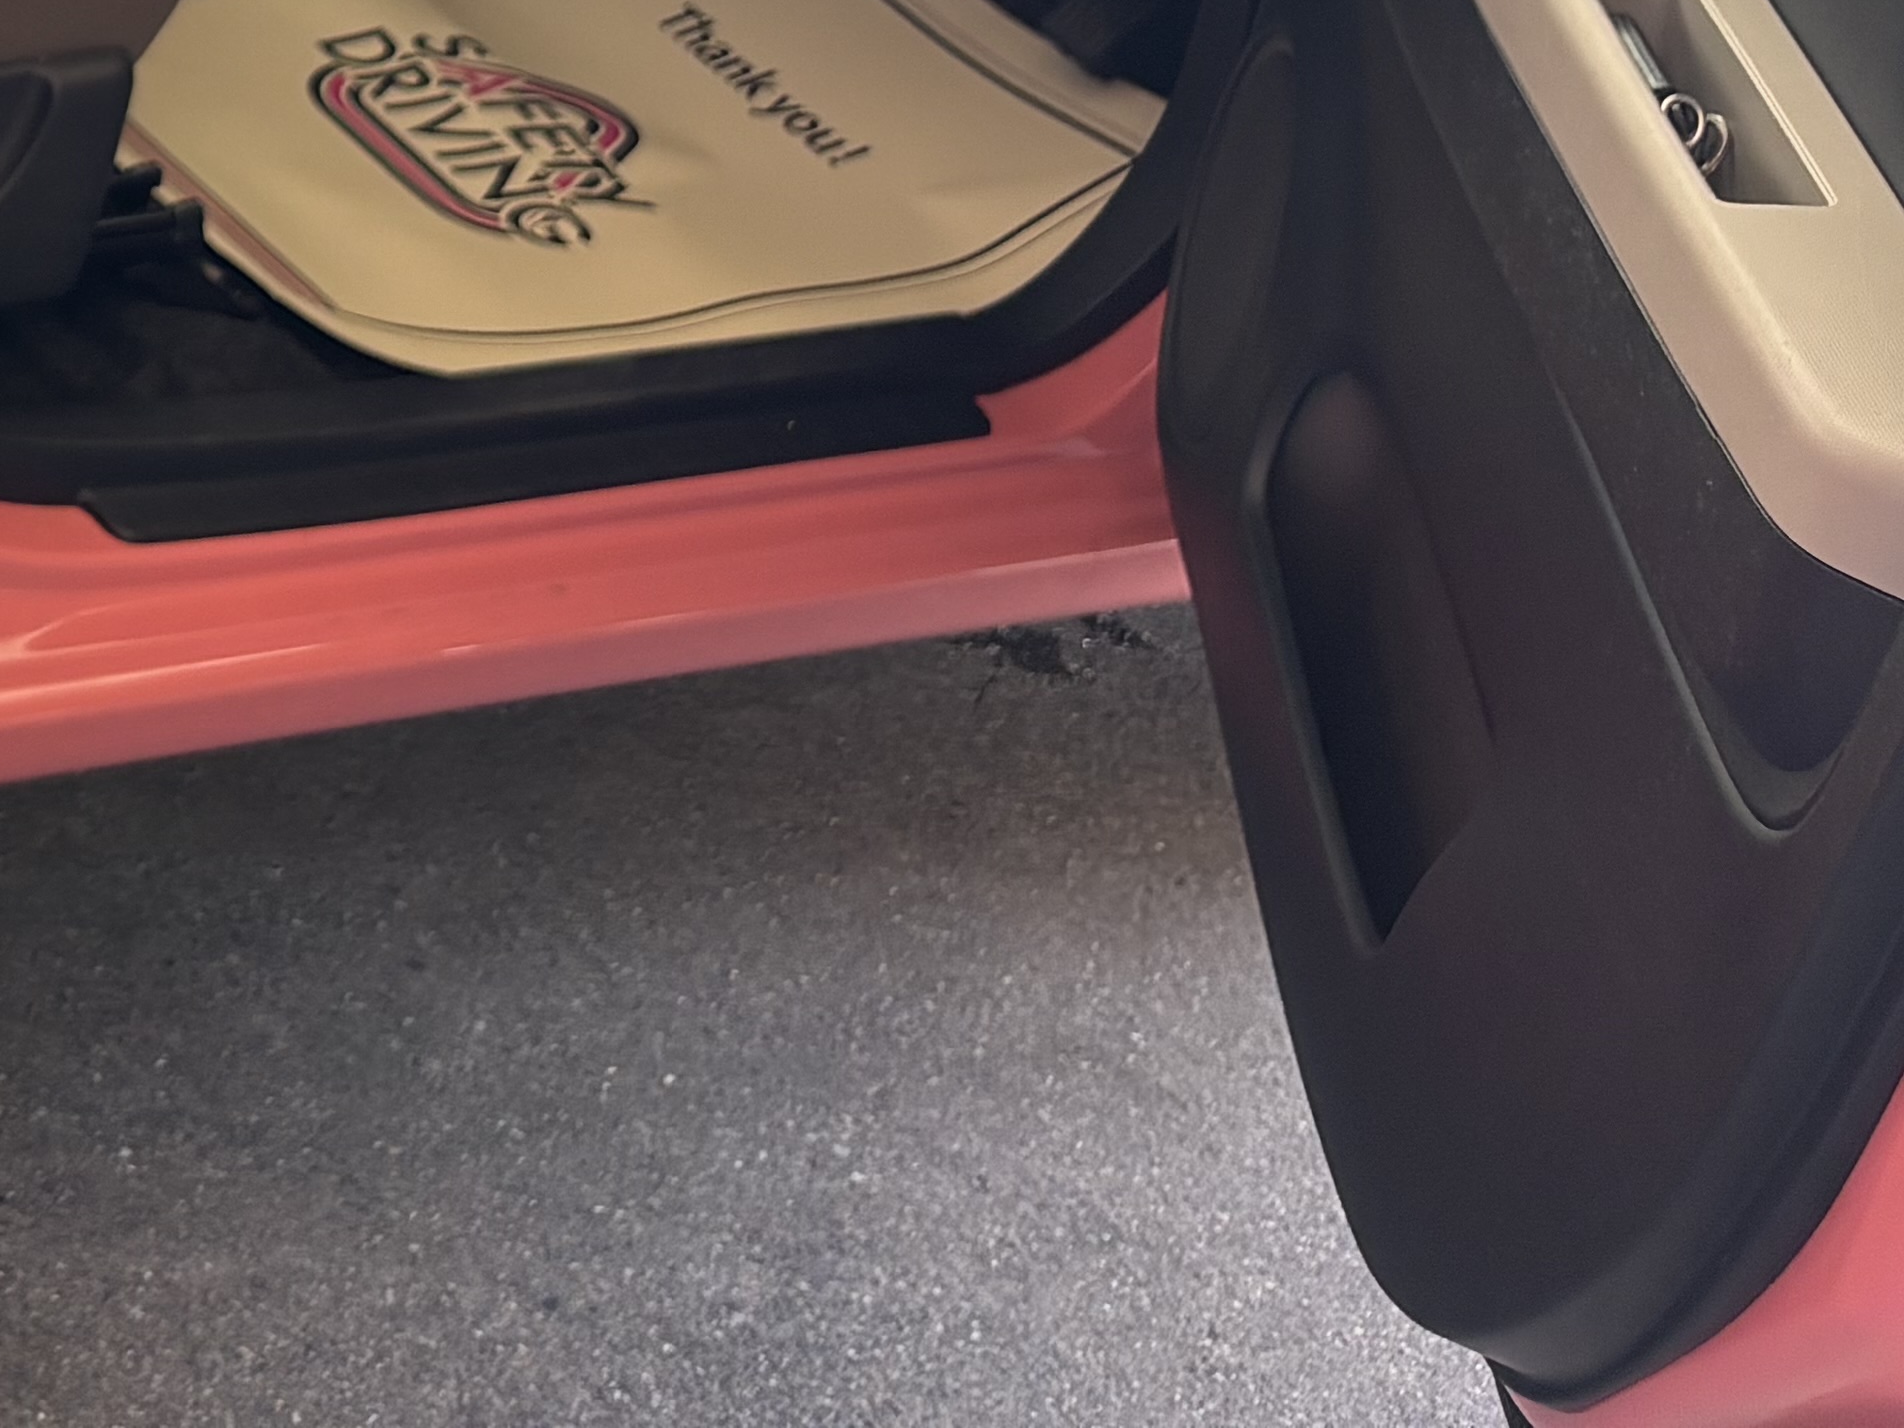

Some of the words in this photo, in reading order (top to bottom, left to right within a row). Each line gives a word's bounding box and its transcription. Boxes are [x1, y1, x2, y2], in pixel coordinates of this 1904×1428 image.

[317, 25, 592, 246] DRIVING
[659, 2, 778, 100] Thank
[749, 94, 871, 167] you!
